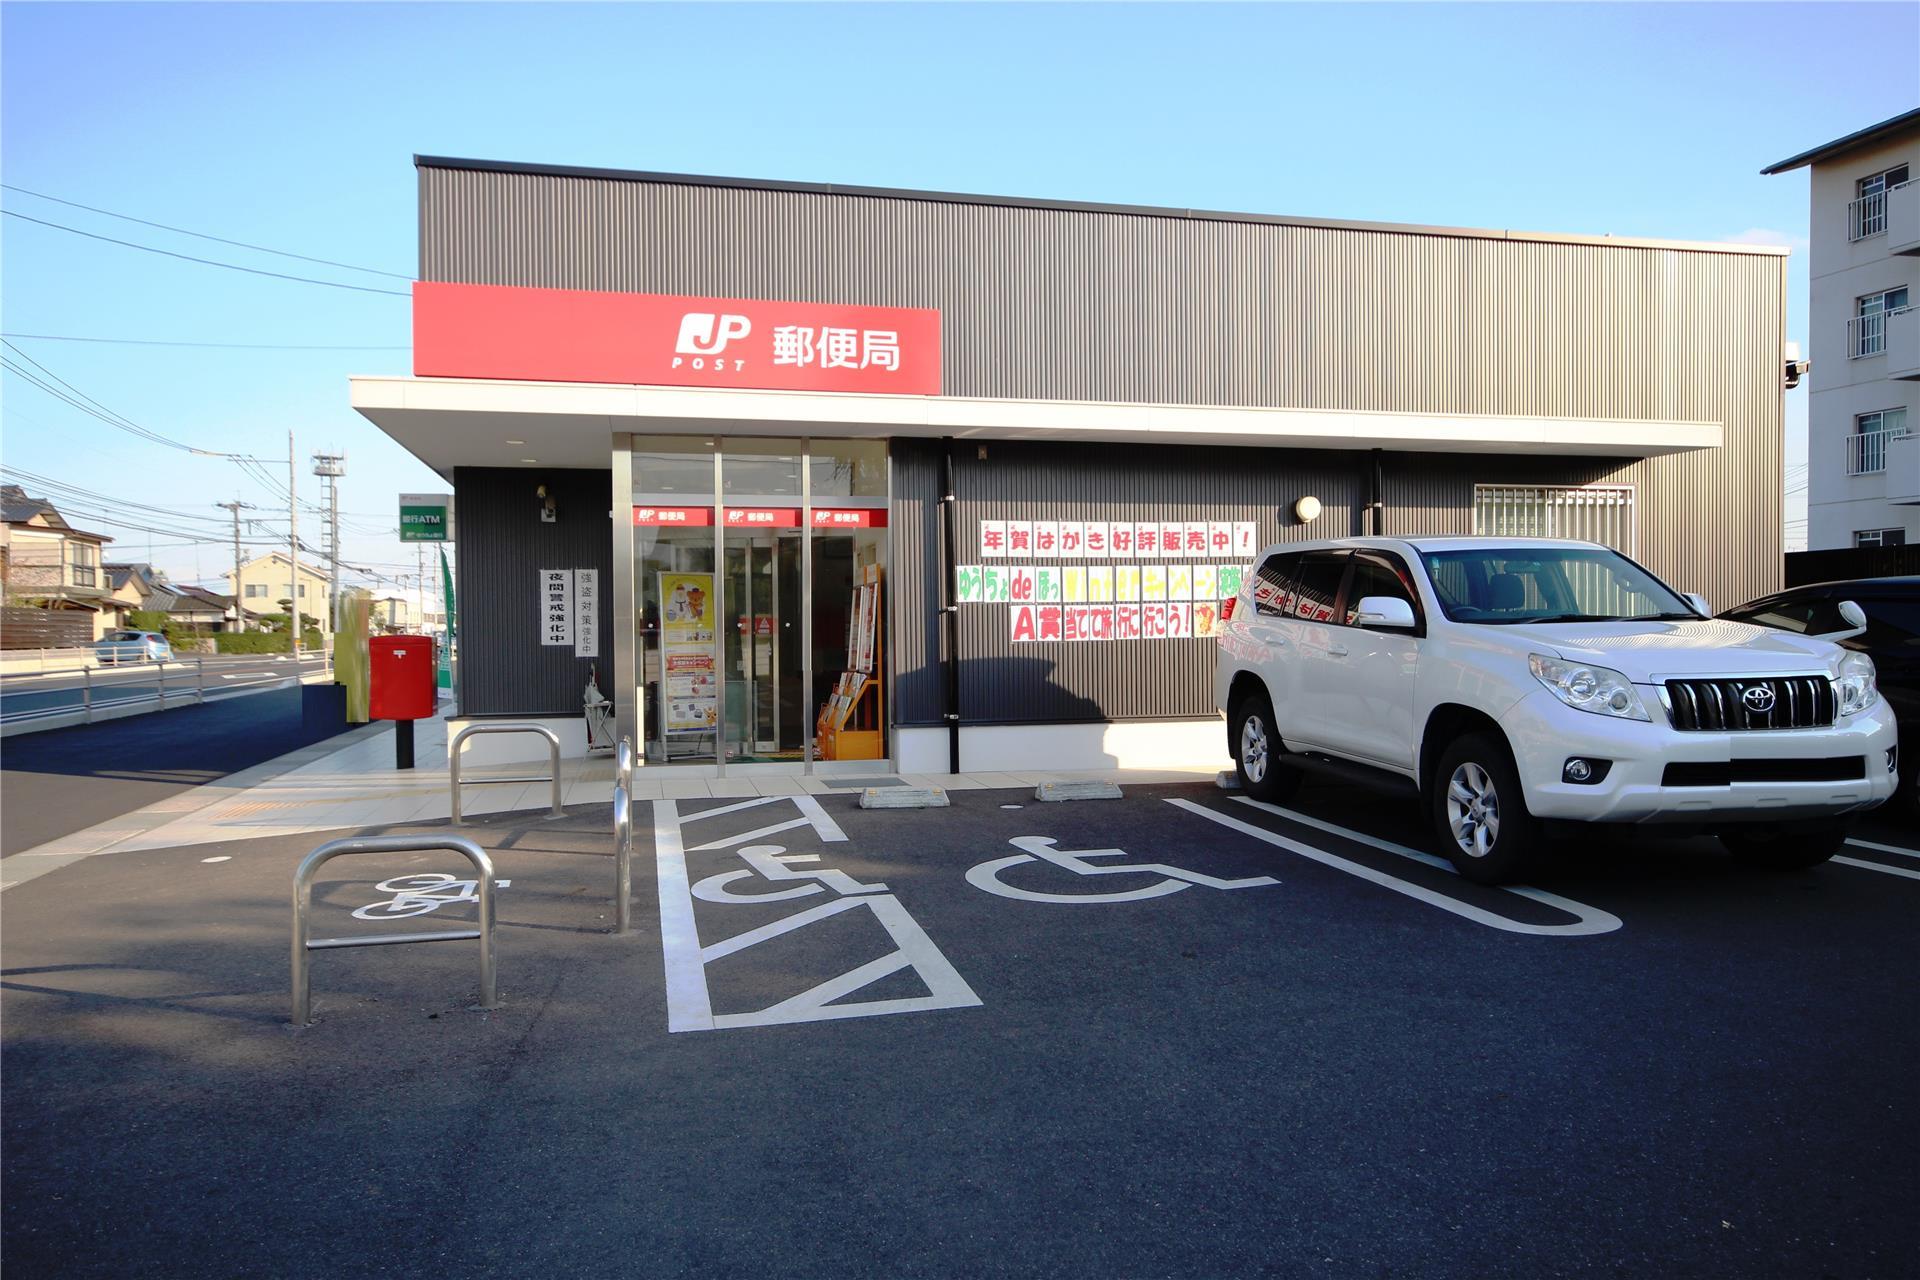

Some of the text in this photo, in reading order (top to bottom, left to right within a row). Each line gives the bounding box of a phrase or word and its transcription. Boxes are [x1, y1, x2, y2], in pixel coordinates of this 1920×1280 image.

[674, 313, 751, 355] JP
[773, 325, 900, 372] 郵便局
[672, 357, 745, 372] POST
[983, 530, 1249, 551] 年賀はがき好評販売中！
[549, 573, 565, 643] 夜間警戒強化中
